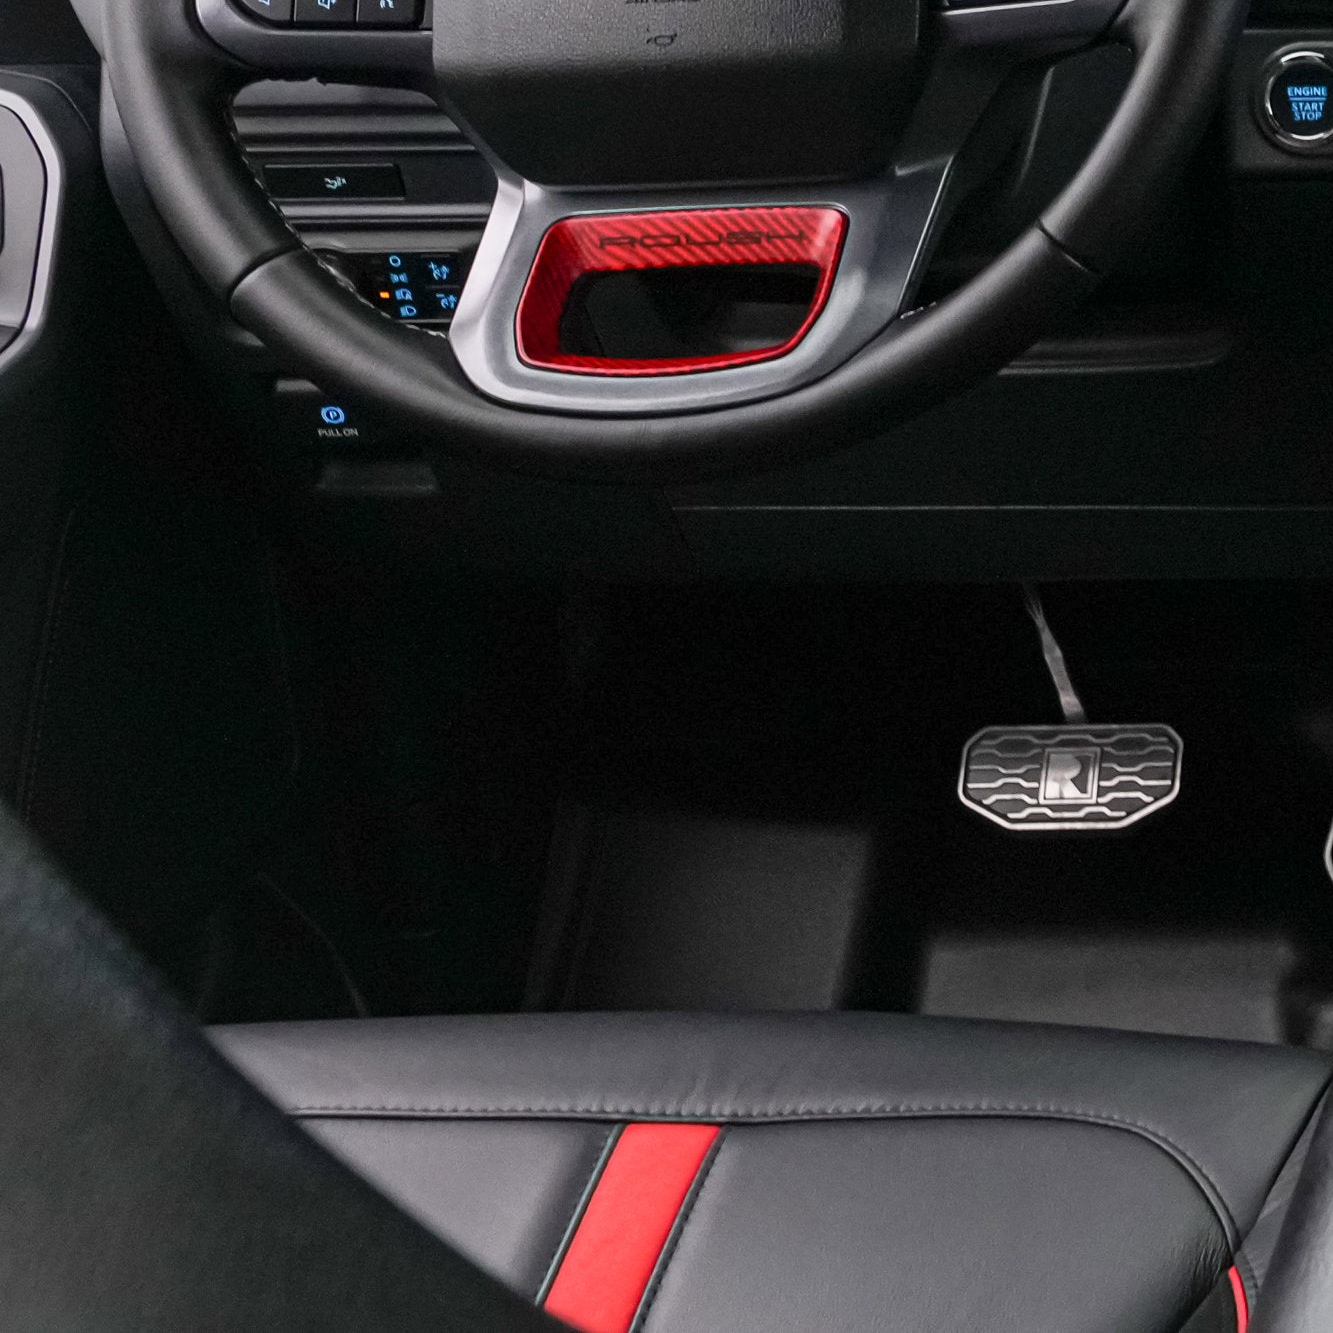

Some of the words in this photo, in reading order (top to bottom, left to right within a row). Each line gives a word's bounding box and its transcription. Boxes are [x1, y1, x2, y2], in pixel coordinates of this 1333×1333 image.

[1287, 86, 1328, 97] ENGINE
[1291, 101, 1325, 112] START
[1294, 112, 1322, 121] STOP
[317, 428, 342, 438] PULL
[342, 427, 359, 437] ON
